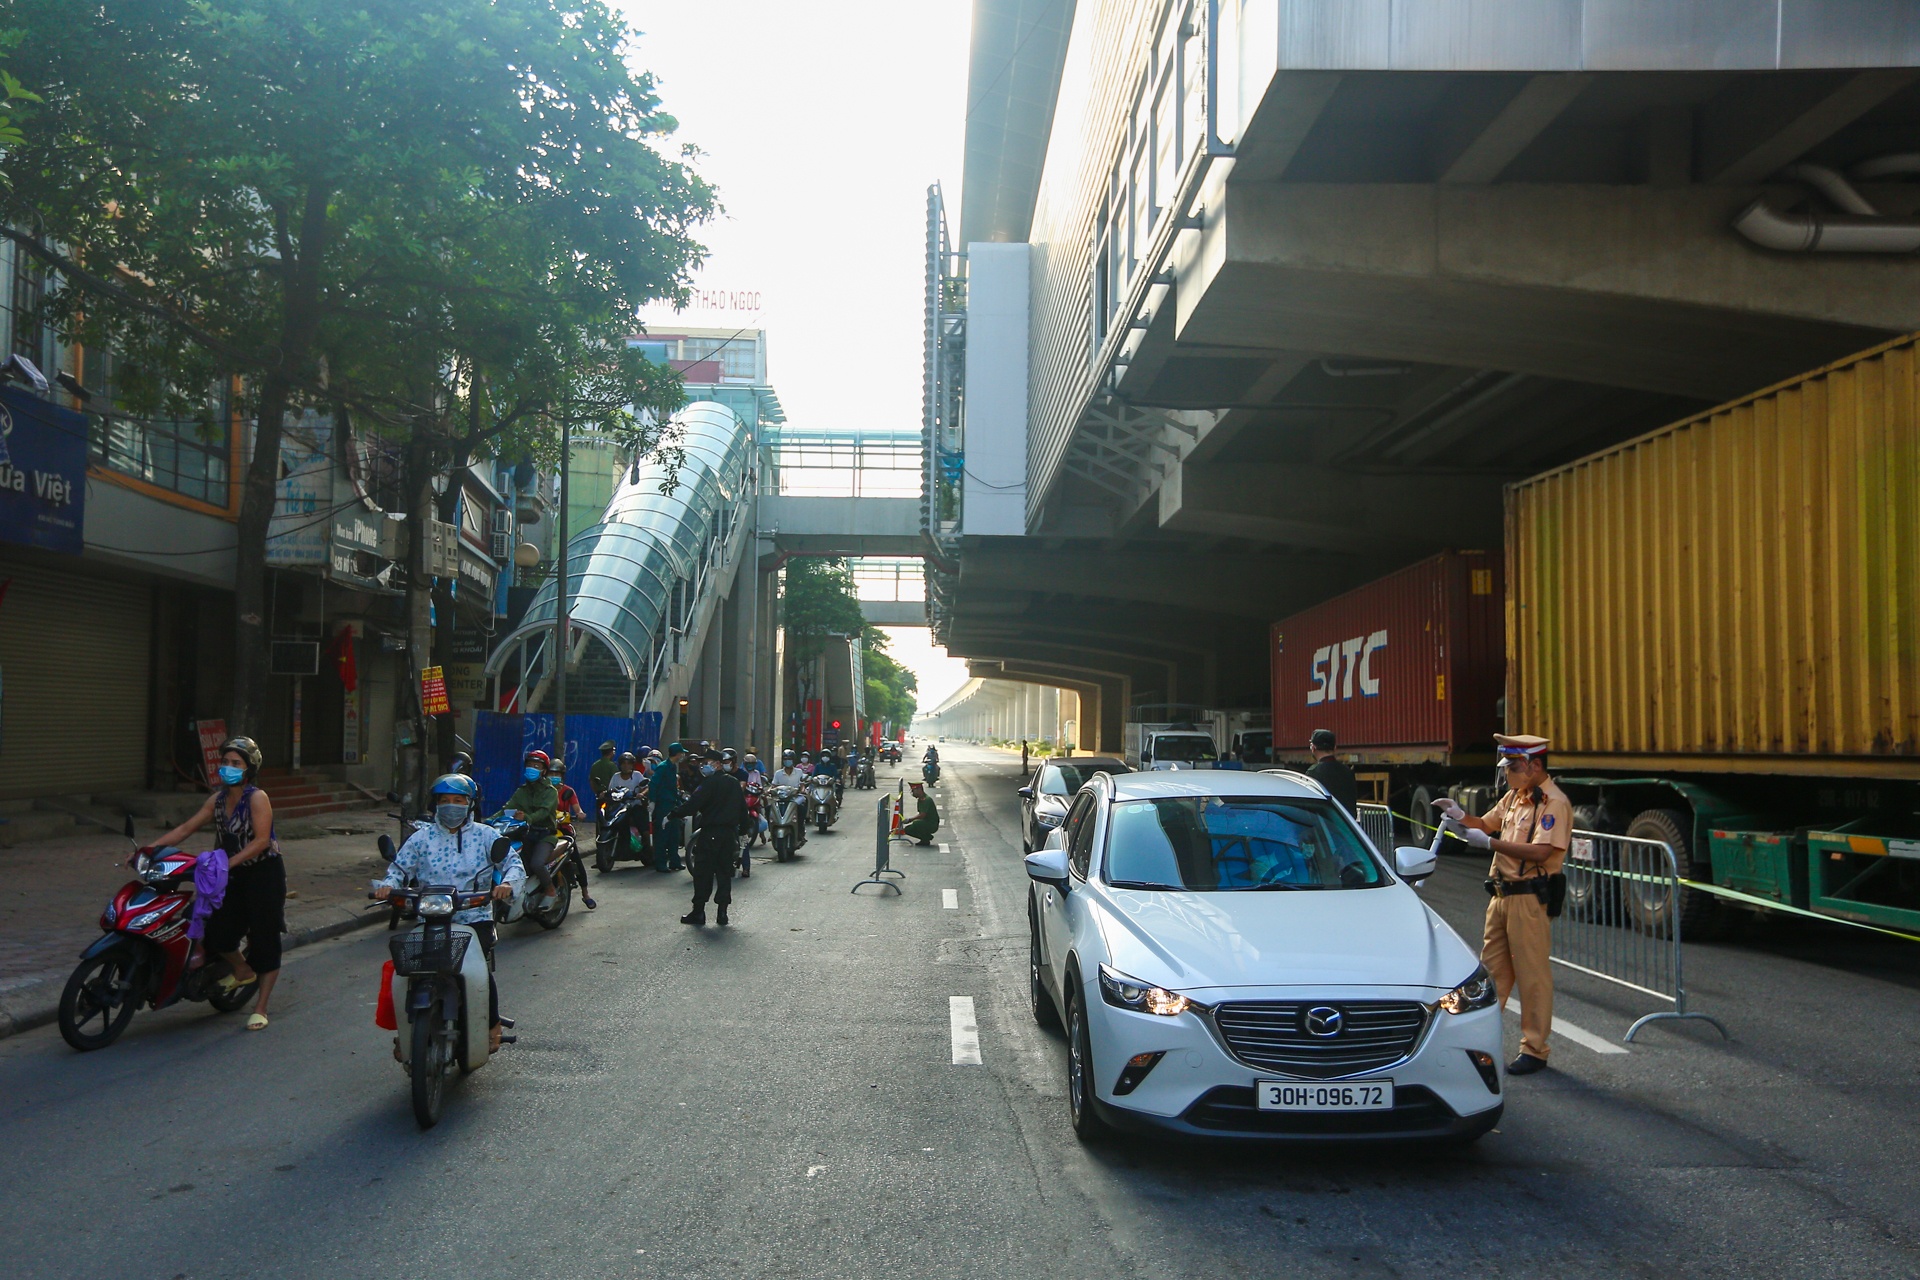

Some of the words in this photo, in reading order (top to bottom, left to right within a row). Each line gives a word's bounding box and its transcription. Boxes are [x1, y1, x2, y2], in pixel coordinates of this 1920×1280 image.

[34, 469, 72, 508] Việt
[354, 518, 377, 548] iPhone
[1306, 629, 1388, 707] SITC
[452, 679, 482, 690] ENTER
[1269, 1086, 1383, 1106] 30H-096.72
